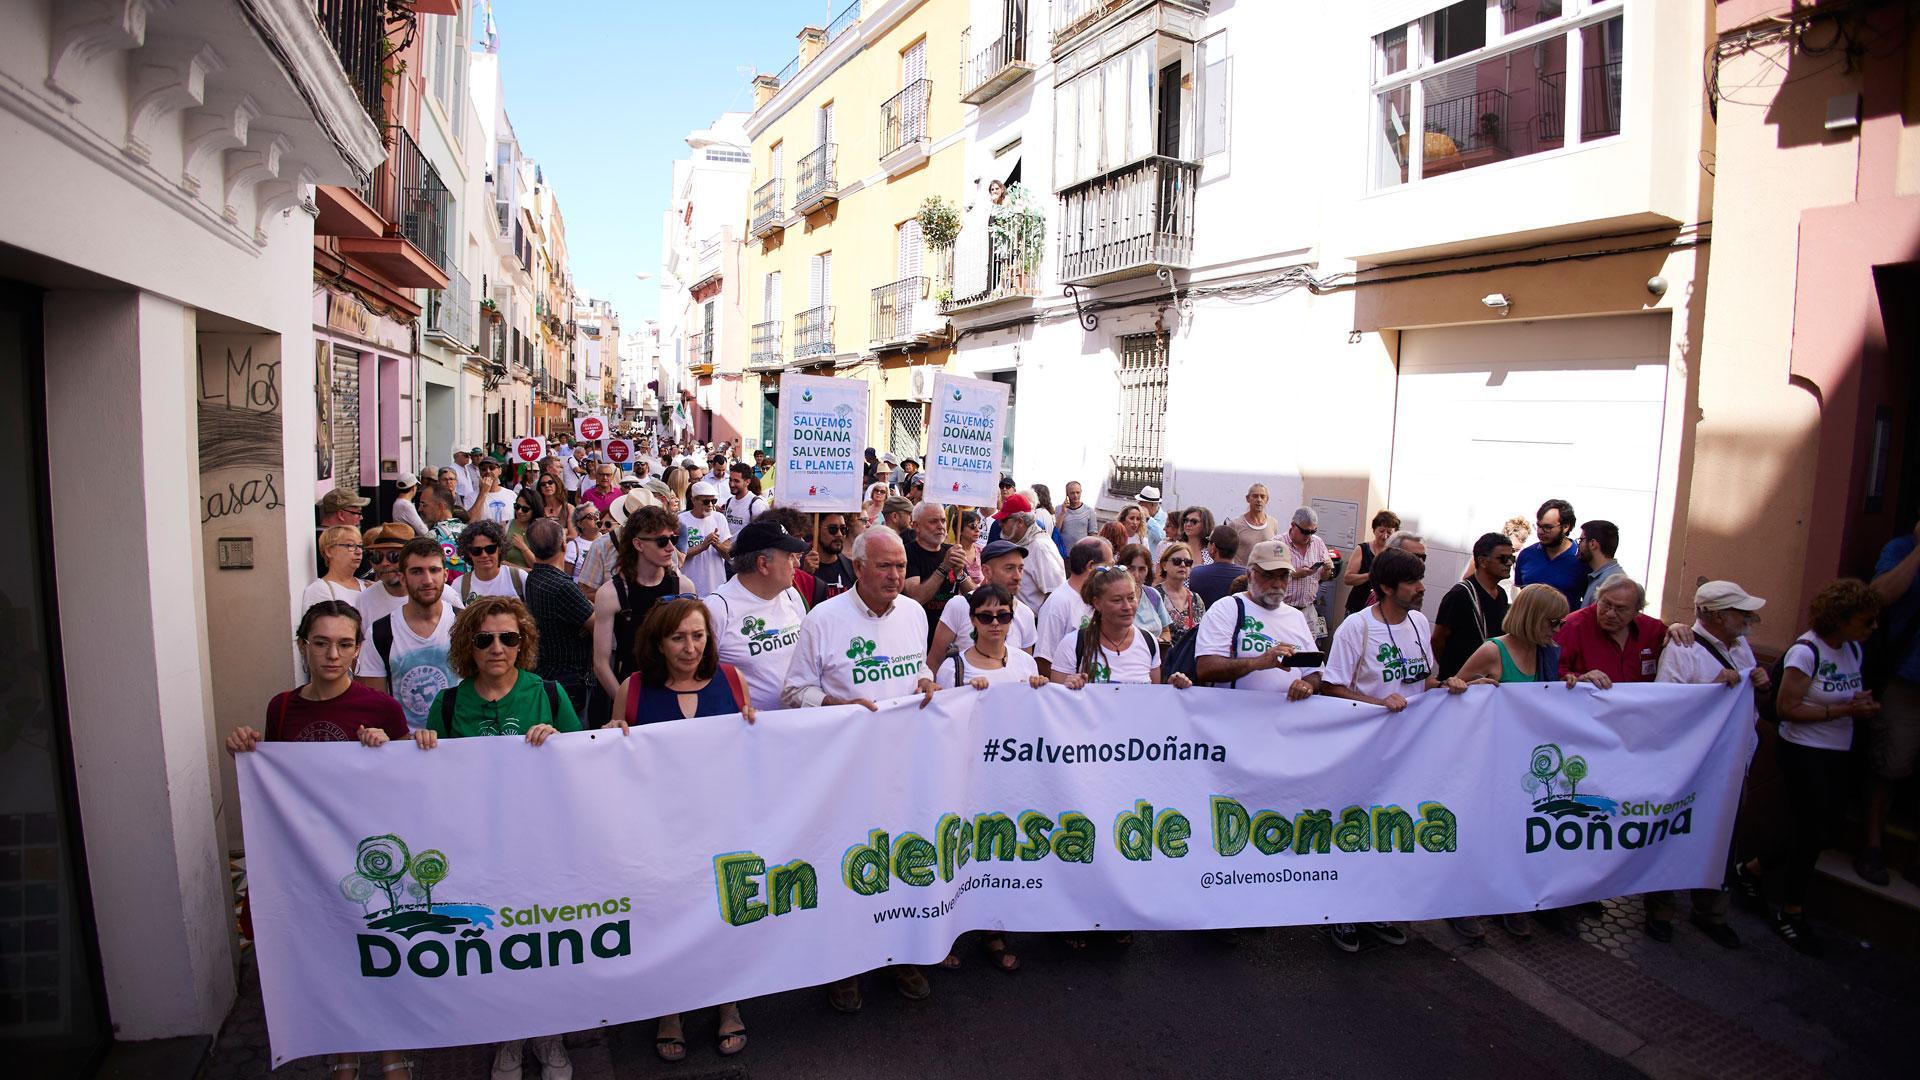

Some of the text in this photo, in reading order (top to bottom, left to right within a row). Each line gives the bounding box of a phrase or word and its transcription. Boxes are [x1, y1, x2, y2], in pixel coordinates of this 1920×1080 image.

[793, 416, 853, 429] SALVEMOS
[944, 413, 994, 428] SALVEMOS
[793, 427, 851, 442] DOÑANA
[943, 425, 992, 442] DOÑANA
[792, 446, 851, 457] SALVEMOS
[941, 442, 991, 457] SALVEMOS
[790, 460, 854, 470] EL PLANETA
[938, 455, 949, 466] EL
[952, 456, 992, 470] PLANETA
[890, 651, 922, 664] Salvemo
[983, 735, 1227, 764] #SalvemosDoñana
[1621, 792, 1697, 817] Salvemos
[1525, 808, 1693, 854] Doñana
[712, 794, 1457, 926] En defensa de Doñana
[1200, 869, 1339, 889] @SalvemosDonana
[499, 896, 632, 928] Salvemos
[356, 919, 632, 978] Doñana
